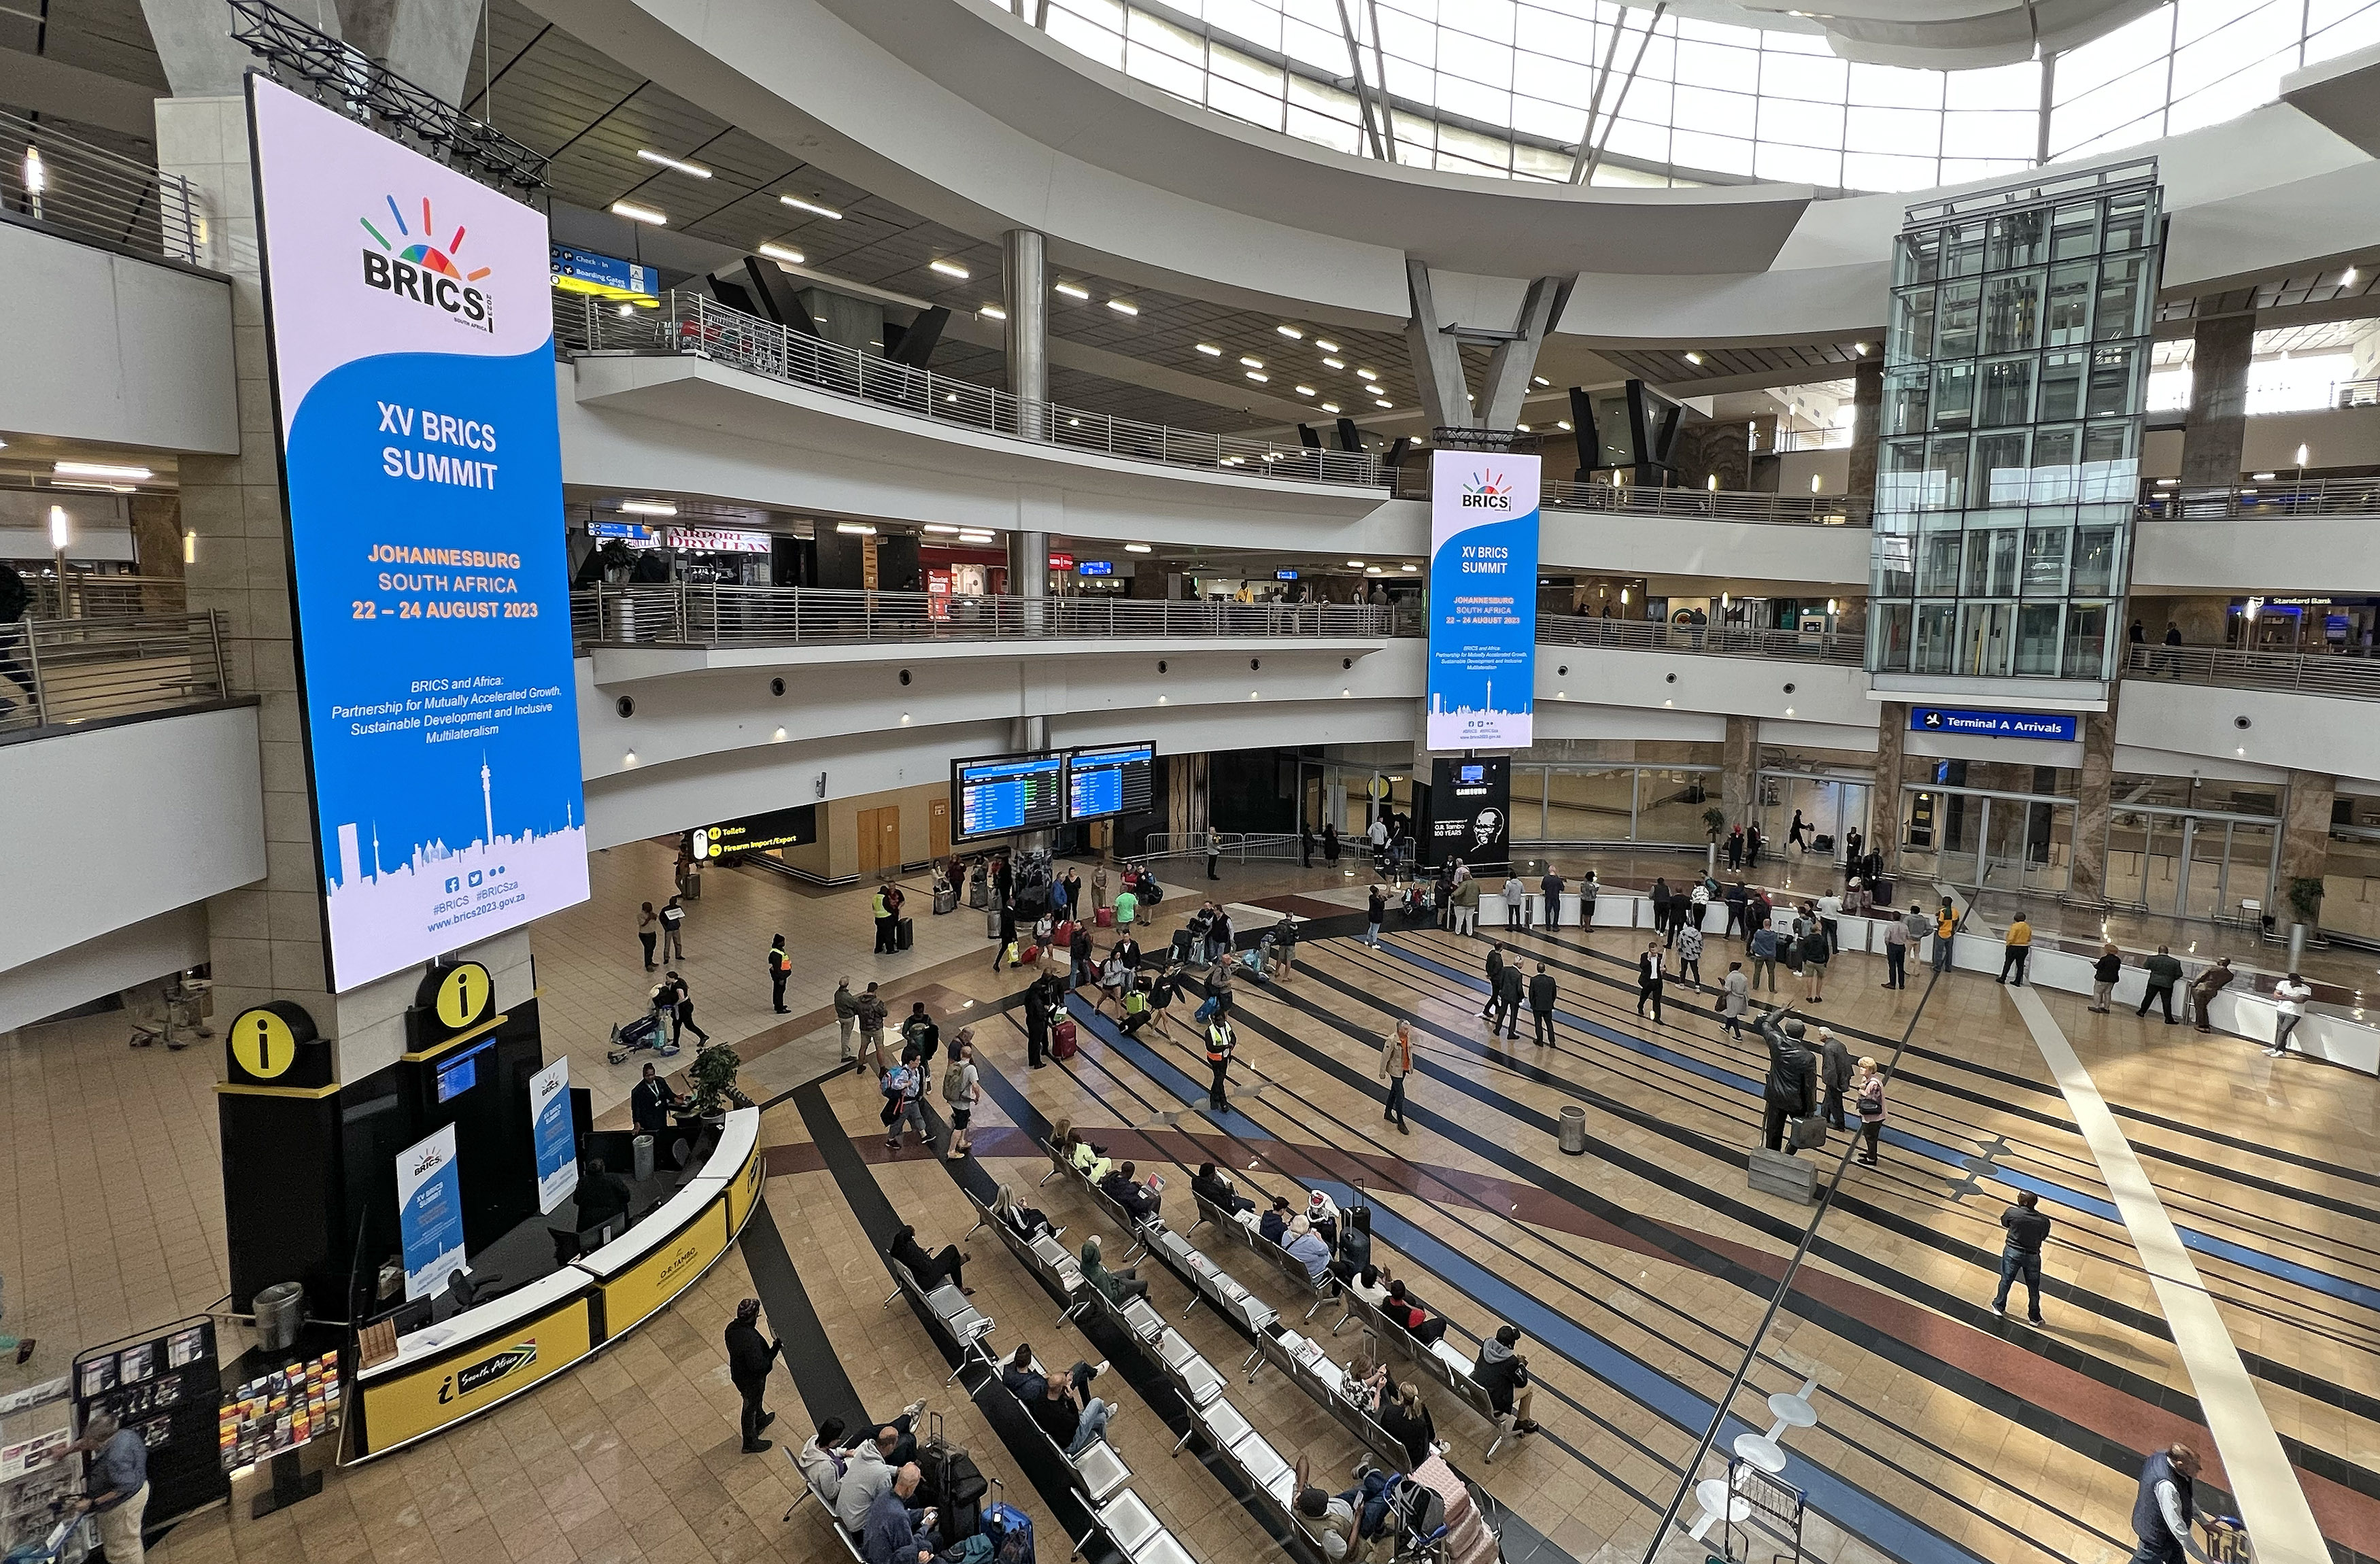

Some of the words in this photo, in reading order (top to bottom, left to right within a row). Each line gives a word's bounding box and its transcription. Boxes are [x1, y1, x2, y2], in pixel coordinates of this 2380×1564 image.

[576, 256, 596, 266] Check
[362, 248, 485, 321] BRICS
[576, 268, 606, 282] Boarding
[606, 275, 625, 286] Gates
[454, 317, 470, 326] SOUTH
[471, 322, 488, 332] AFRICA
[377, 401, 414, 436] XV
[422, 410, 496, 453] BRICS
[382, 446, 498, 490] SUMMIT
[1462, 494, 1508, 508] BRICS
[669, 528, 743, 541] AIRPORT
[667, 536, 769, 552] DRYCLEAN
[1462, 546, 1476, 558] XV
[1478, 547, 1508, 559] BRICS
[368, 544, 521, 569] JOHANNESBURG
[1462, 562, 1508, 574] SUMMIT
[378, 573, 448, 592] SOUTH
[454, 576, 517, 594] AFRICA
[352, 601, 376, 619] 22
[399, 601, 422, 619] 24
[426, 602, 498, 618] AUGUST
[504, 602, 539, 618] 2023
[411, 679, 449, 693] BRICS
[452, 677, 471, 690] and
[473, 676, 504, 687] Africa:
[331, 700, 403, 719] Partnership
[406, 698, 422, 711] for
[424, 695, 469, 710] Mutually
[471, 689, 526, 705] Accelerated
[528, 685, 562, 699] Growth,
[350, 717, 420, 736] Sustainable
[424, 711, 492, 730] Development
[494, 707, 512, 719] and
[514, 702, 553, 716] Inclusive
[1947, 717, 1996, 729] Terminal
[2000, 720, 2010, 730] A
[2014, 721, 2062, 733] Arrivals
[426, 724, 499, 744] Multilateralism
[1456, 787, 1487, 796] SAMSUNG
[722, 827, 746, 836] Toilets
[724, 843, 750, 853] Firearm
[433, 896, 470, 915] #BRICS
[476, 881, 519, 901] #BRICSza
[427, 893, 526, 932] www.brics2023.gov.za
[414, 1156, 440, 1176] BRICS
[462, 1366, 489, 1387] South
[491, 1355, 518, 1373] Africa
